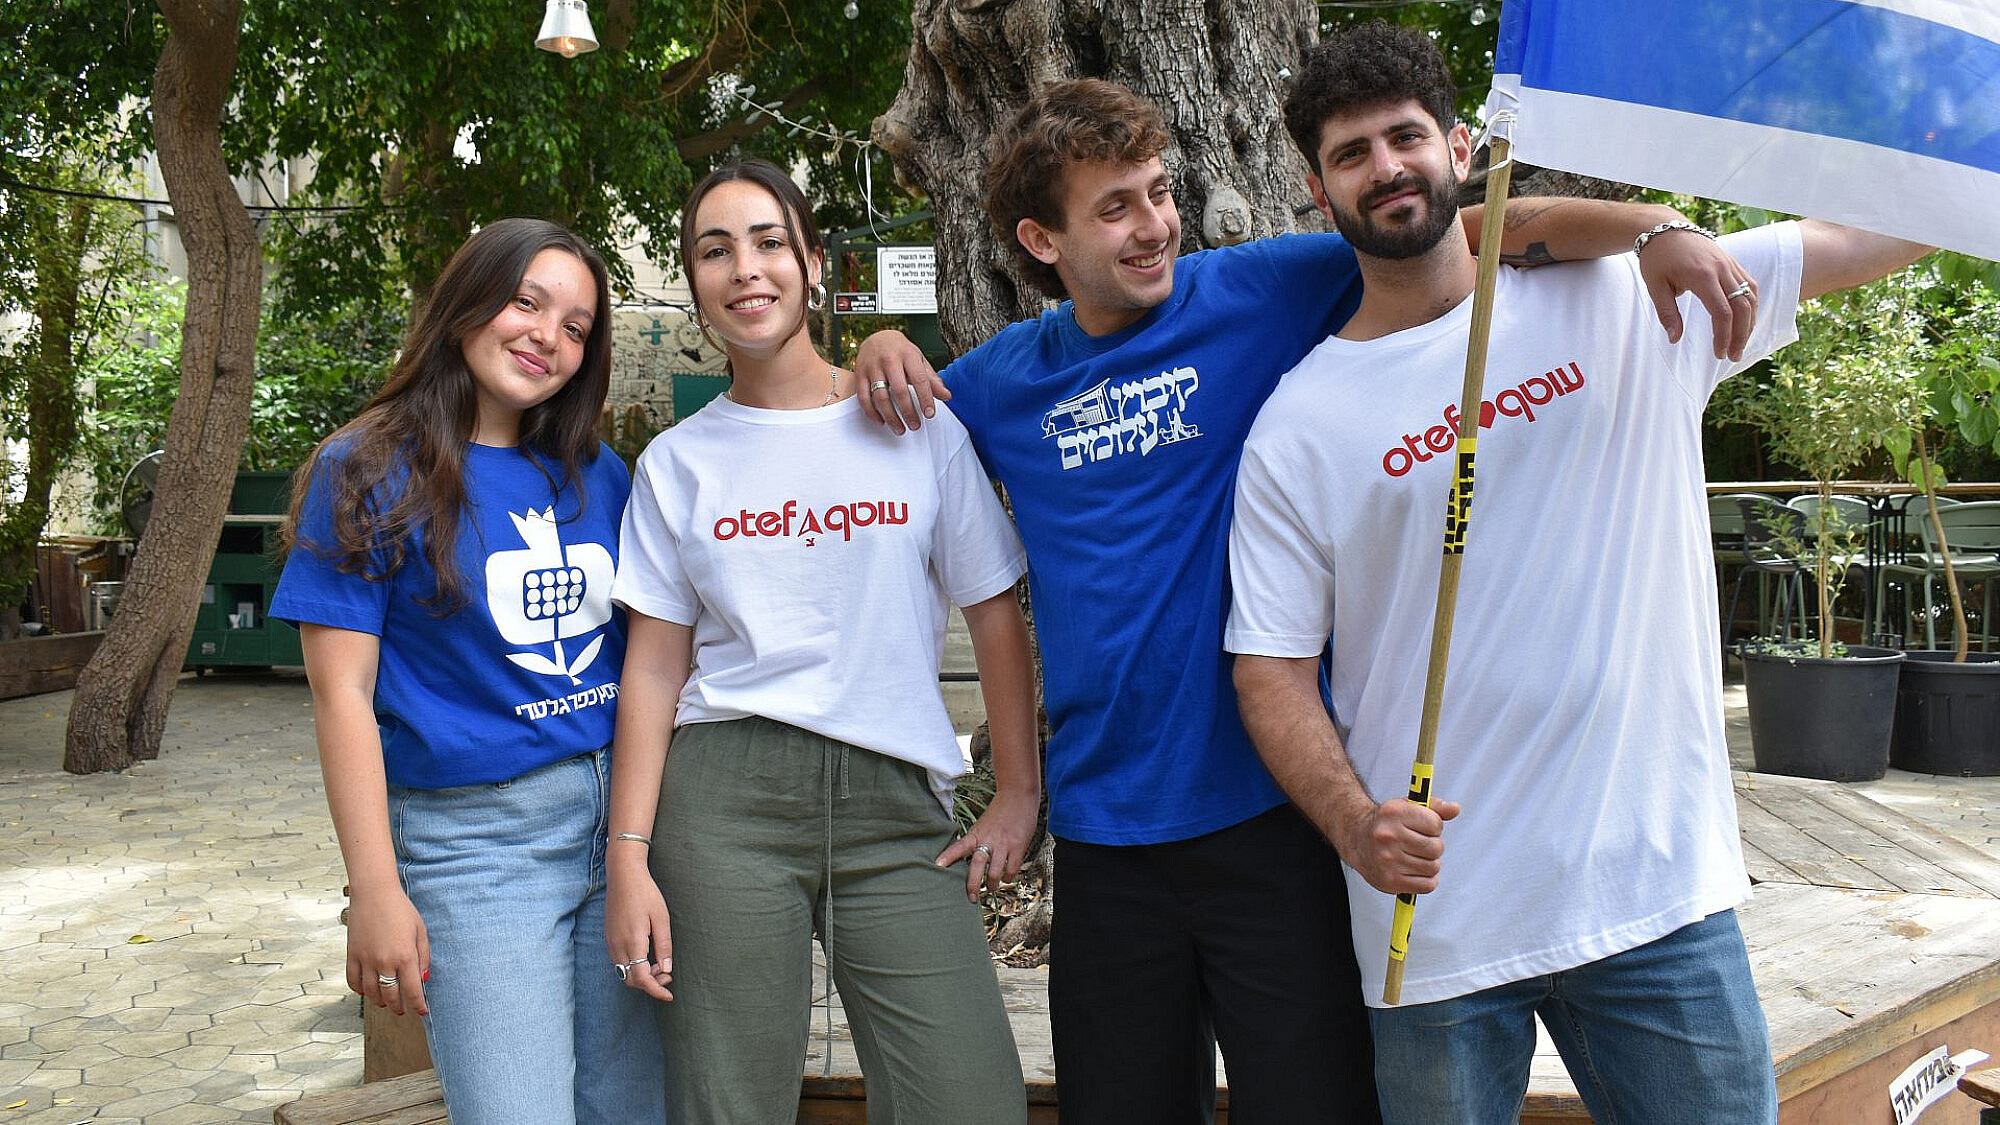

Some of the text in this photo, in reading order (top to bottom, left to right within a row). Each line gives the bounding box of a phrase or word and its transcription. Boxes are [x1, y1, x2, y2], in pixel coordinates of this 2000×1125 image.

[1110, 366, 1199, 424] קיבוץ
[1495, 361, 1585, 423] עוטף
[1057, 410, 1159, 471] עלומים
[1382, 403, 1461, 477] otef
[713, 500, 797, 541] otef
[823, 500, 909, 542] עוטף
[567, 687, 598, 710] כפר
